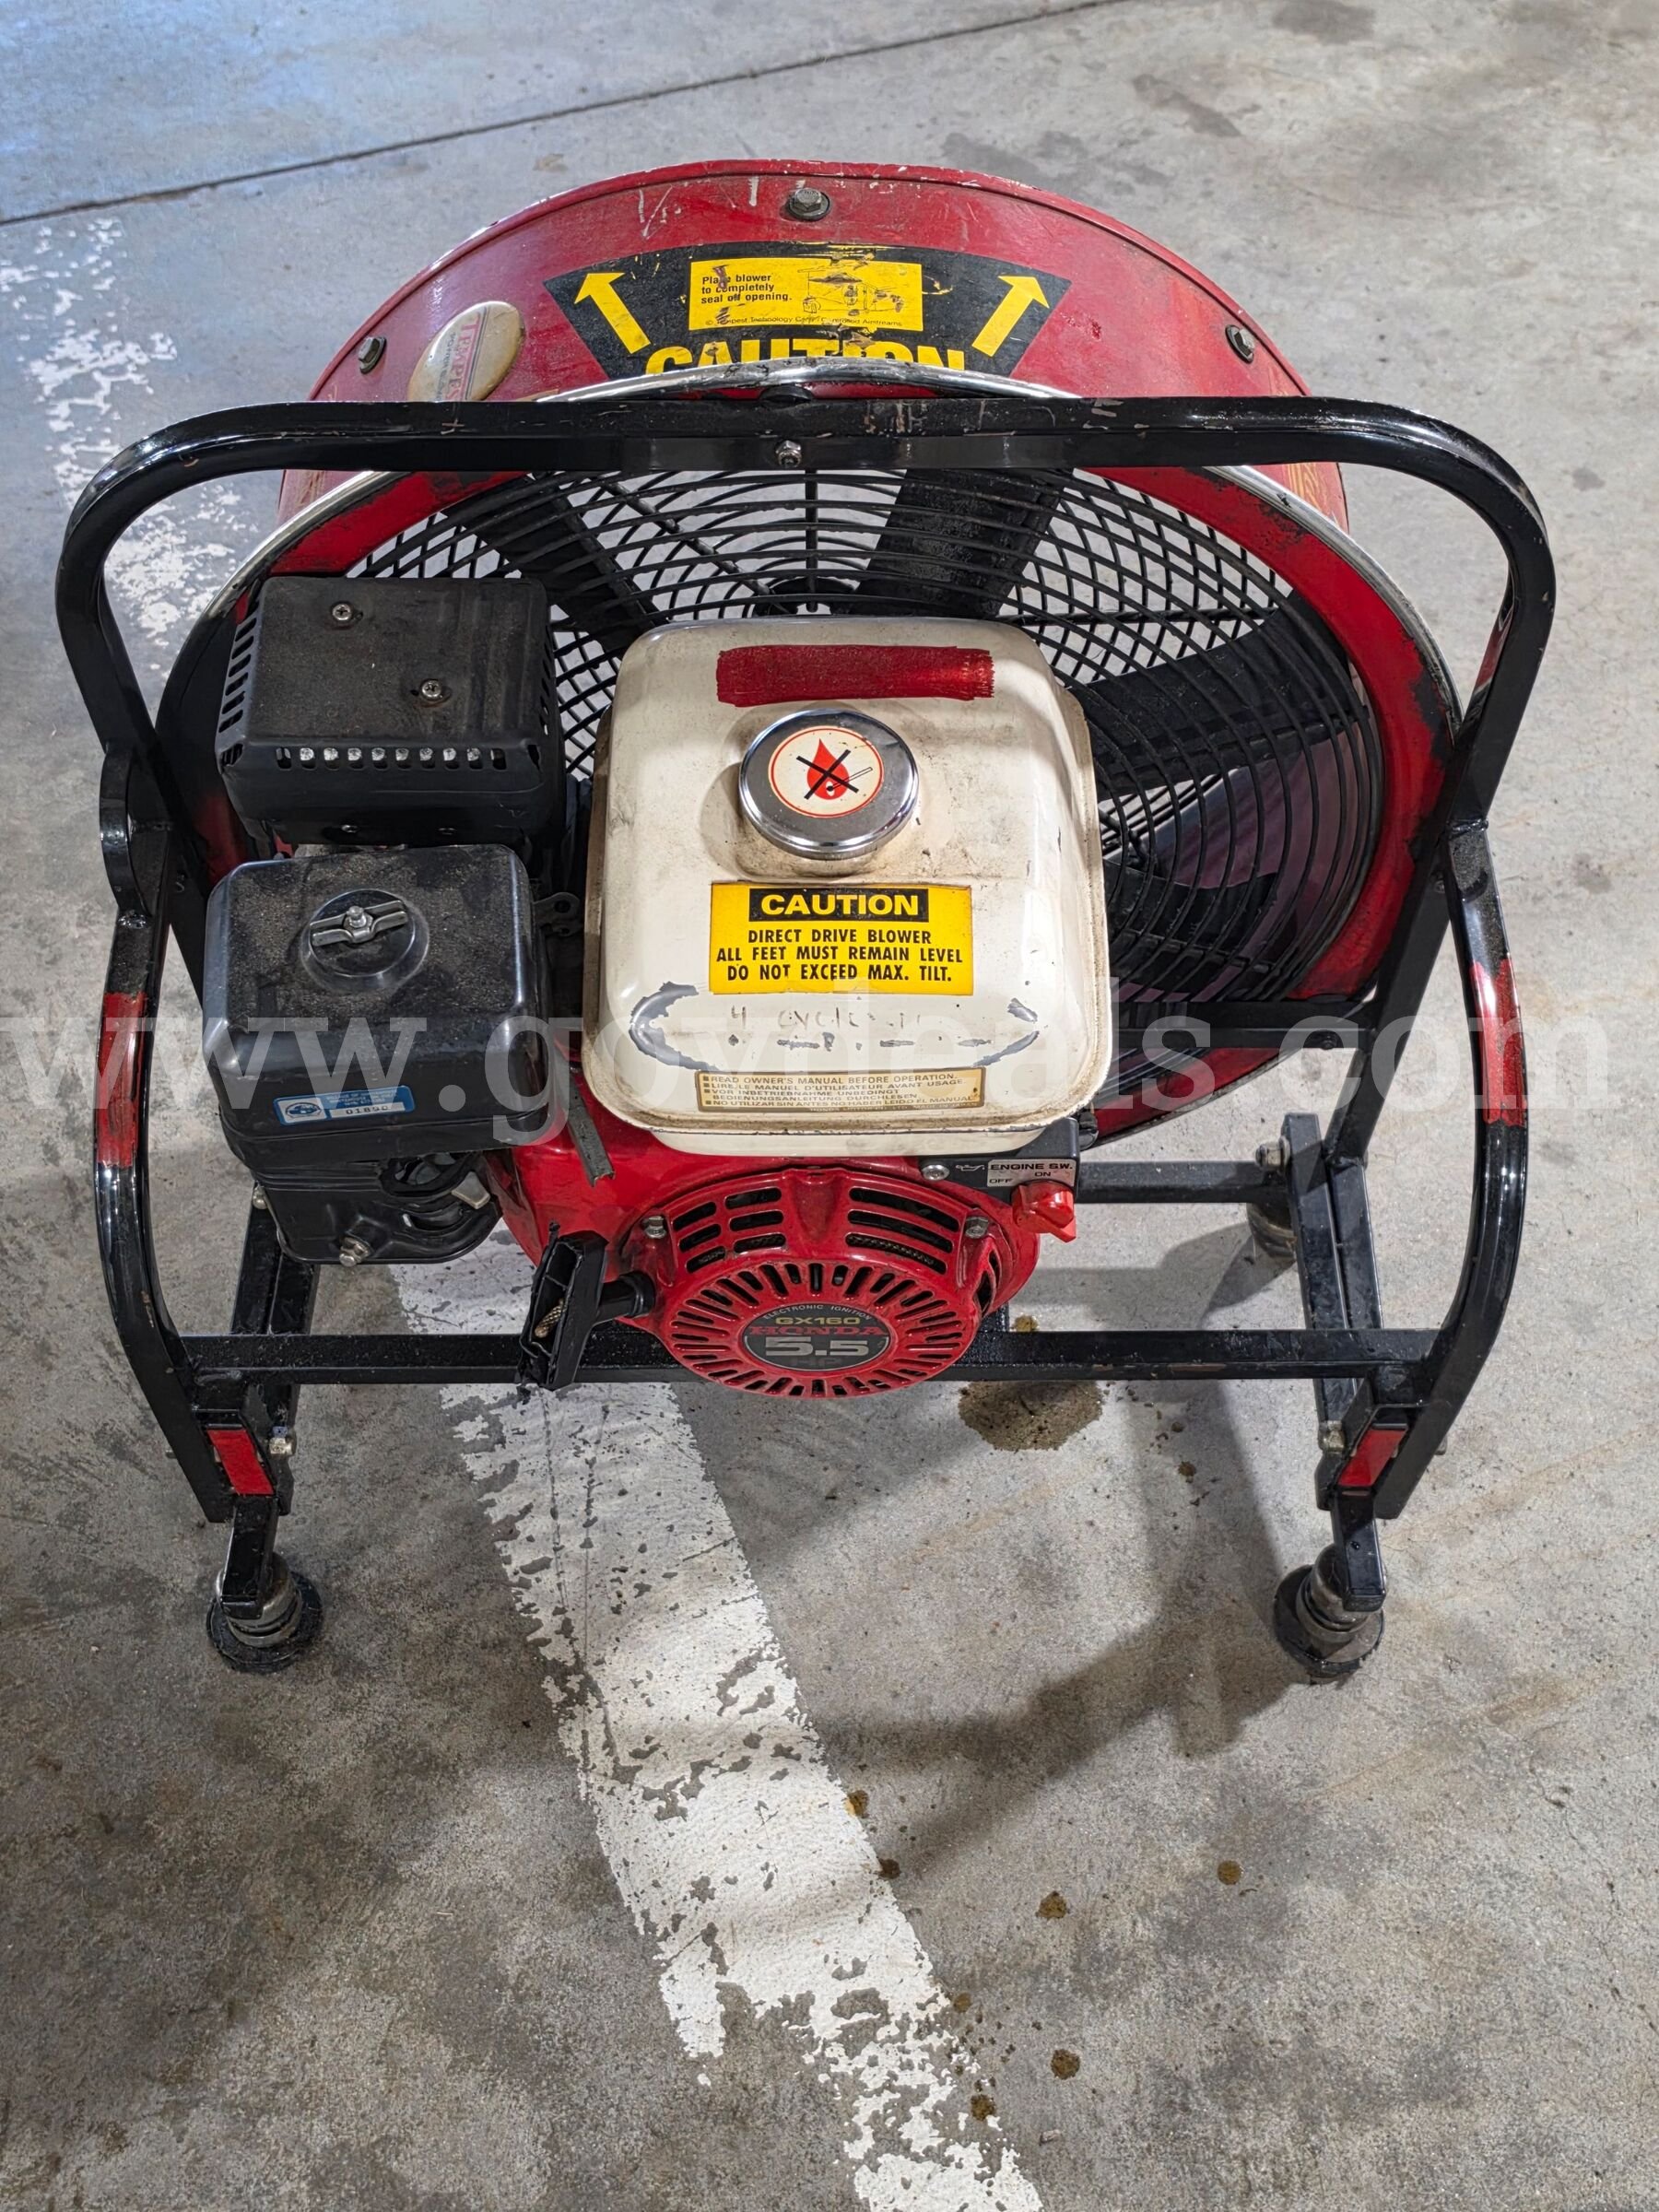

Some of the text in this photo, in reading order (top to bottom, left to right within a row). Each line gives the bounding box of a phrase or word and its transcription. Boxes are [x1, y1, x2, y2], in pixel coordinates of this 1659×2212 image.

[701, 276, 731, 285] Plae
[700, 295, 724, 304] seal
[745, 291, 793, 301] opening.
[750, 315, 793, 324] Technology
[820, 316, 861, 325] Cntrolled
[760, 894, 918, 916] CAUTION
[747, 929, 932, 945] DIRECT DRIVE BLOWER
[716, 946, 963, 963] ALL FEET MUST REMAIN LEVEL
[727, 964, 952, 982] DO NOT EXCEED MAX. TILT.
[797, 1077, 845, 1085] MANUAL
[848, 1076, 889, 1084] BEFORE
[893, 1073, 959, 1083] OPERATION.
[929, 1095, 972, 1103] MANUAL
[763, 1304, 873, 1320] ELECTRONIC IGNITION
[775, 1316, 861, 1324] GX160
[748, 1325, 887, 1335] HONDA
[765, 1335, 869, 1356] 5.5
